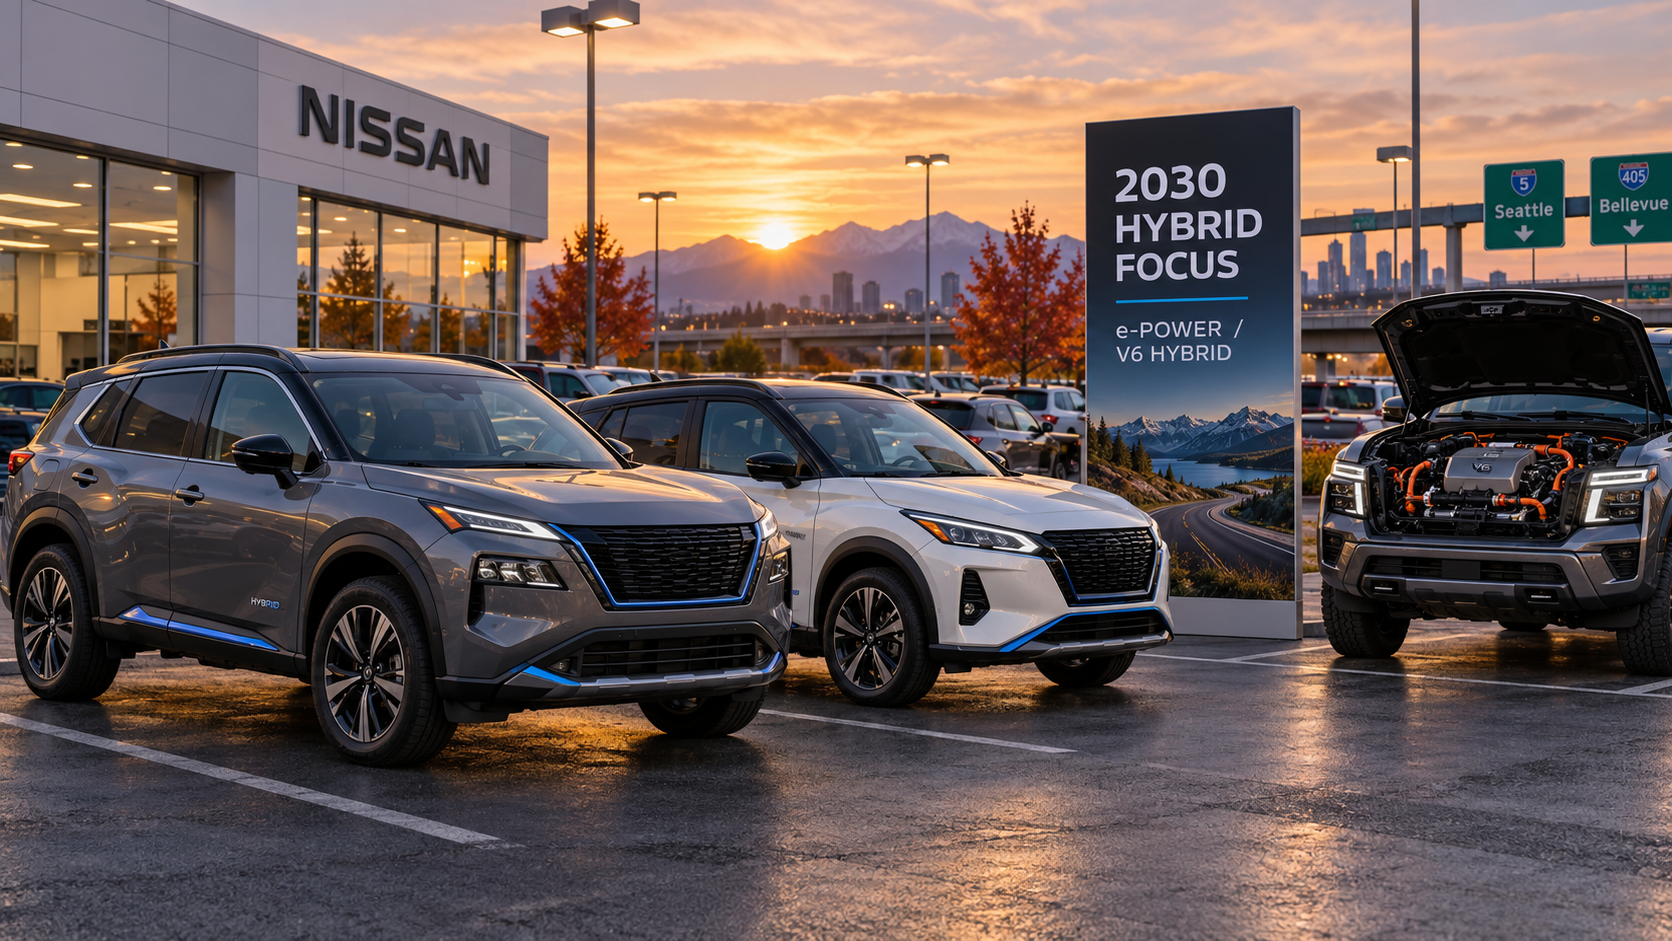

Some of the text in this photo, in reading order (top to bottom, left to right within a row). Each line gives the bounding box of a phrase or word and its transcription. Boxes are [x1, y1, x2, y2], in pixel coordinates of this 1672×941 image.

[299, 85, 490, 185] NISSAN
[1115, 162, 1227, 203] 2030
[1519, 177, 1529, 191] 5
[1622, 169, 1646, 184] 405
[1494, 202, 1554, 219] Seattle
[1599, 197, 1669, 214] Bellevue
[1115, 208, 1263, 244] HYBRID
[1116, 249, 1240, 282] FOCUS
[1115, 318, 1244, 339] e-POWER /
[1115, 344, 1232, 363] V6 HYBRID
